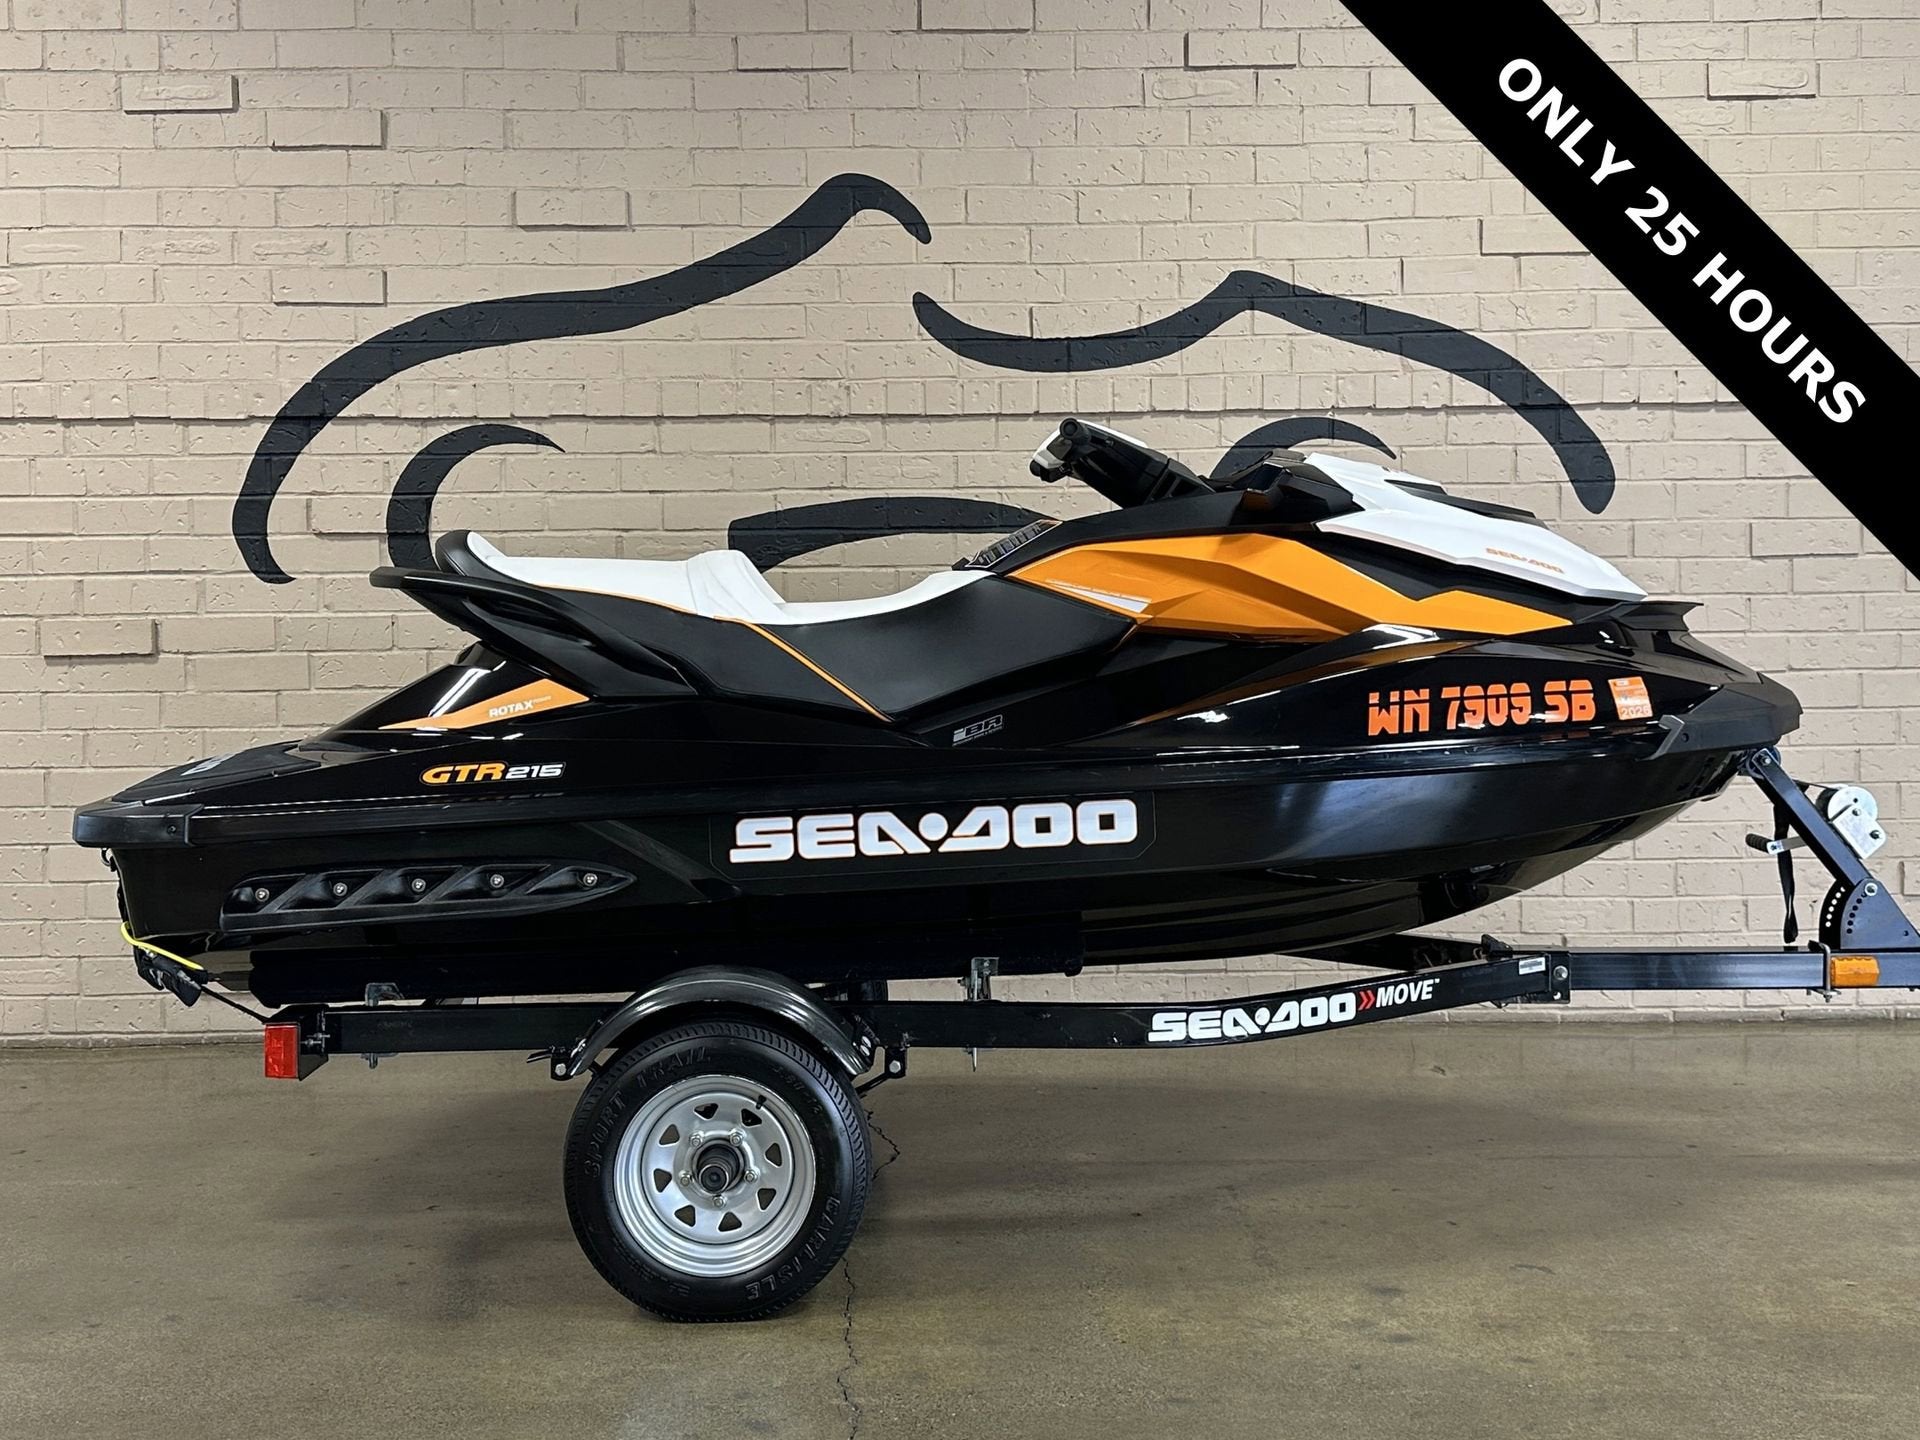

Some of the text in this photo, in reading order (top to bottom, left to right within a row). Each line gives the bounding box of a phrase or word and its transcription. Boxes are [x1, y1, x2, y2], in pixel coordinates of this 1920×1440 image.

[489, 699, 534, 718] ROTAX
[1368, 688, 1430, 736] WN
[1441, 682, 1532, 730] 7909
[1544, 680, 1596, 723] SB
[585, 1047, 712, 1179] SPORT TRAIL
[745, 1195, 842, 1300] CARLISLE
